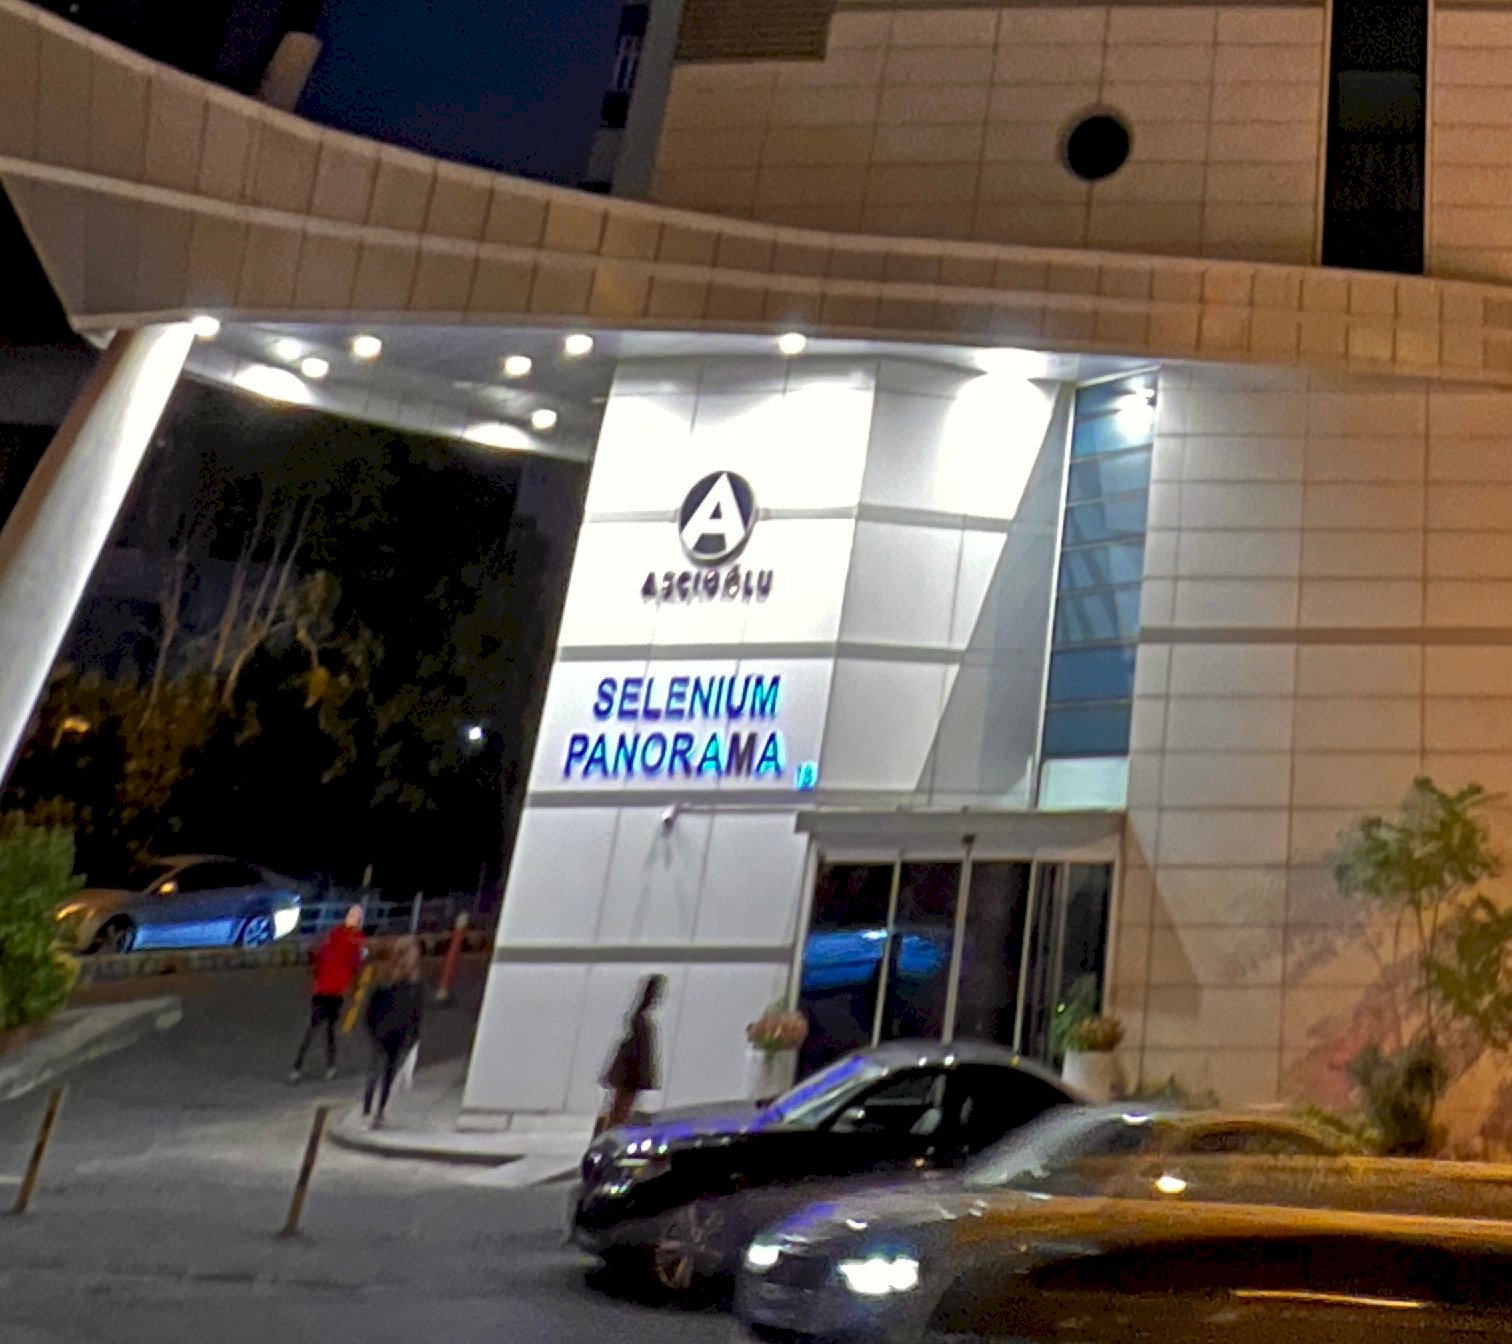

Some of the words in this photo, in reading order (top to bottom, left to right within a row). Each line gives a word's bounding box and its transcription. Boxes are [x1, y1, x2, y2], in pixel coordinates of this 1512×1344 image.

[680, 472, 753, 558] A
[593, 675, 781, 720] SELENIUM
[564, 731, 783, 778] PANORAMA
